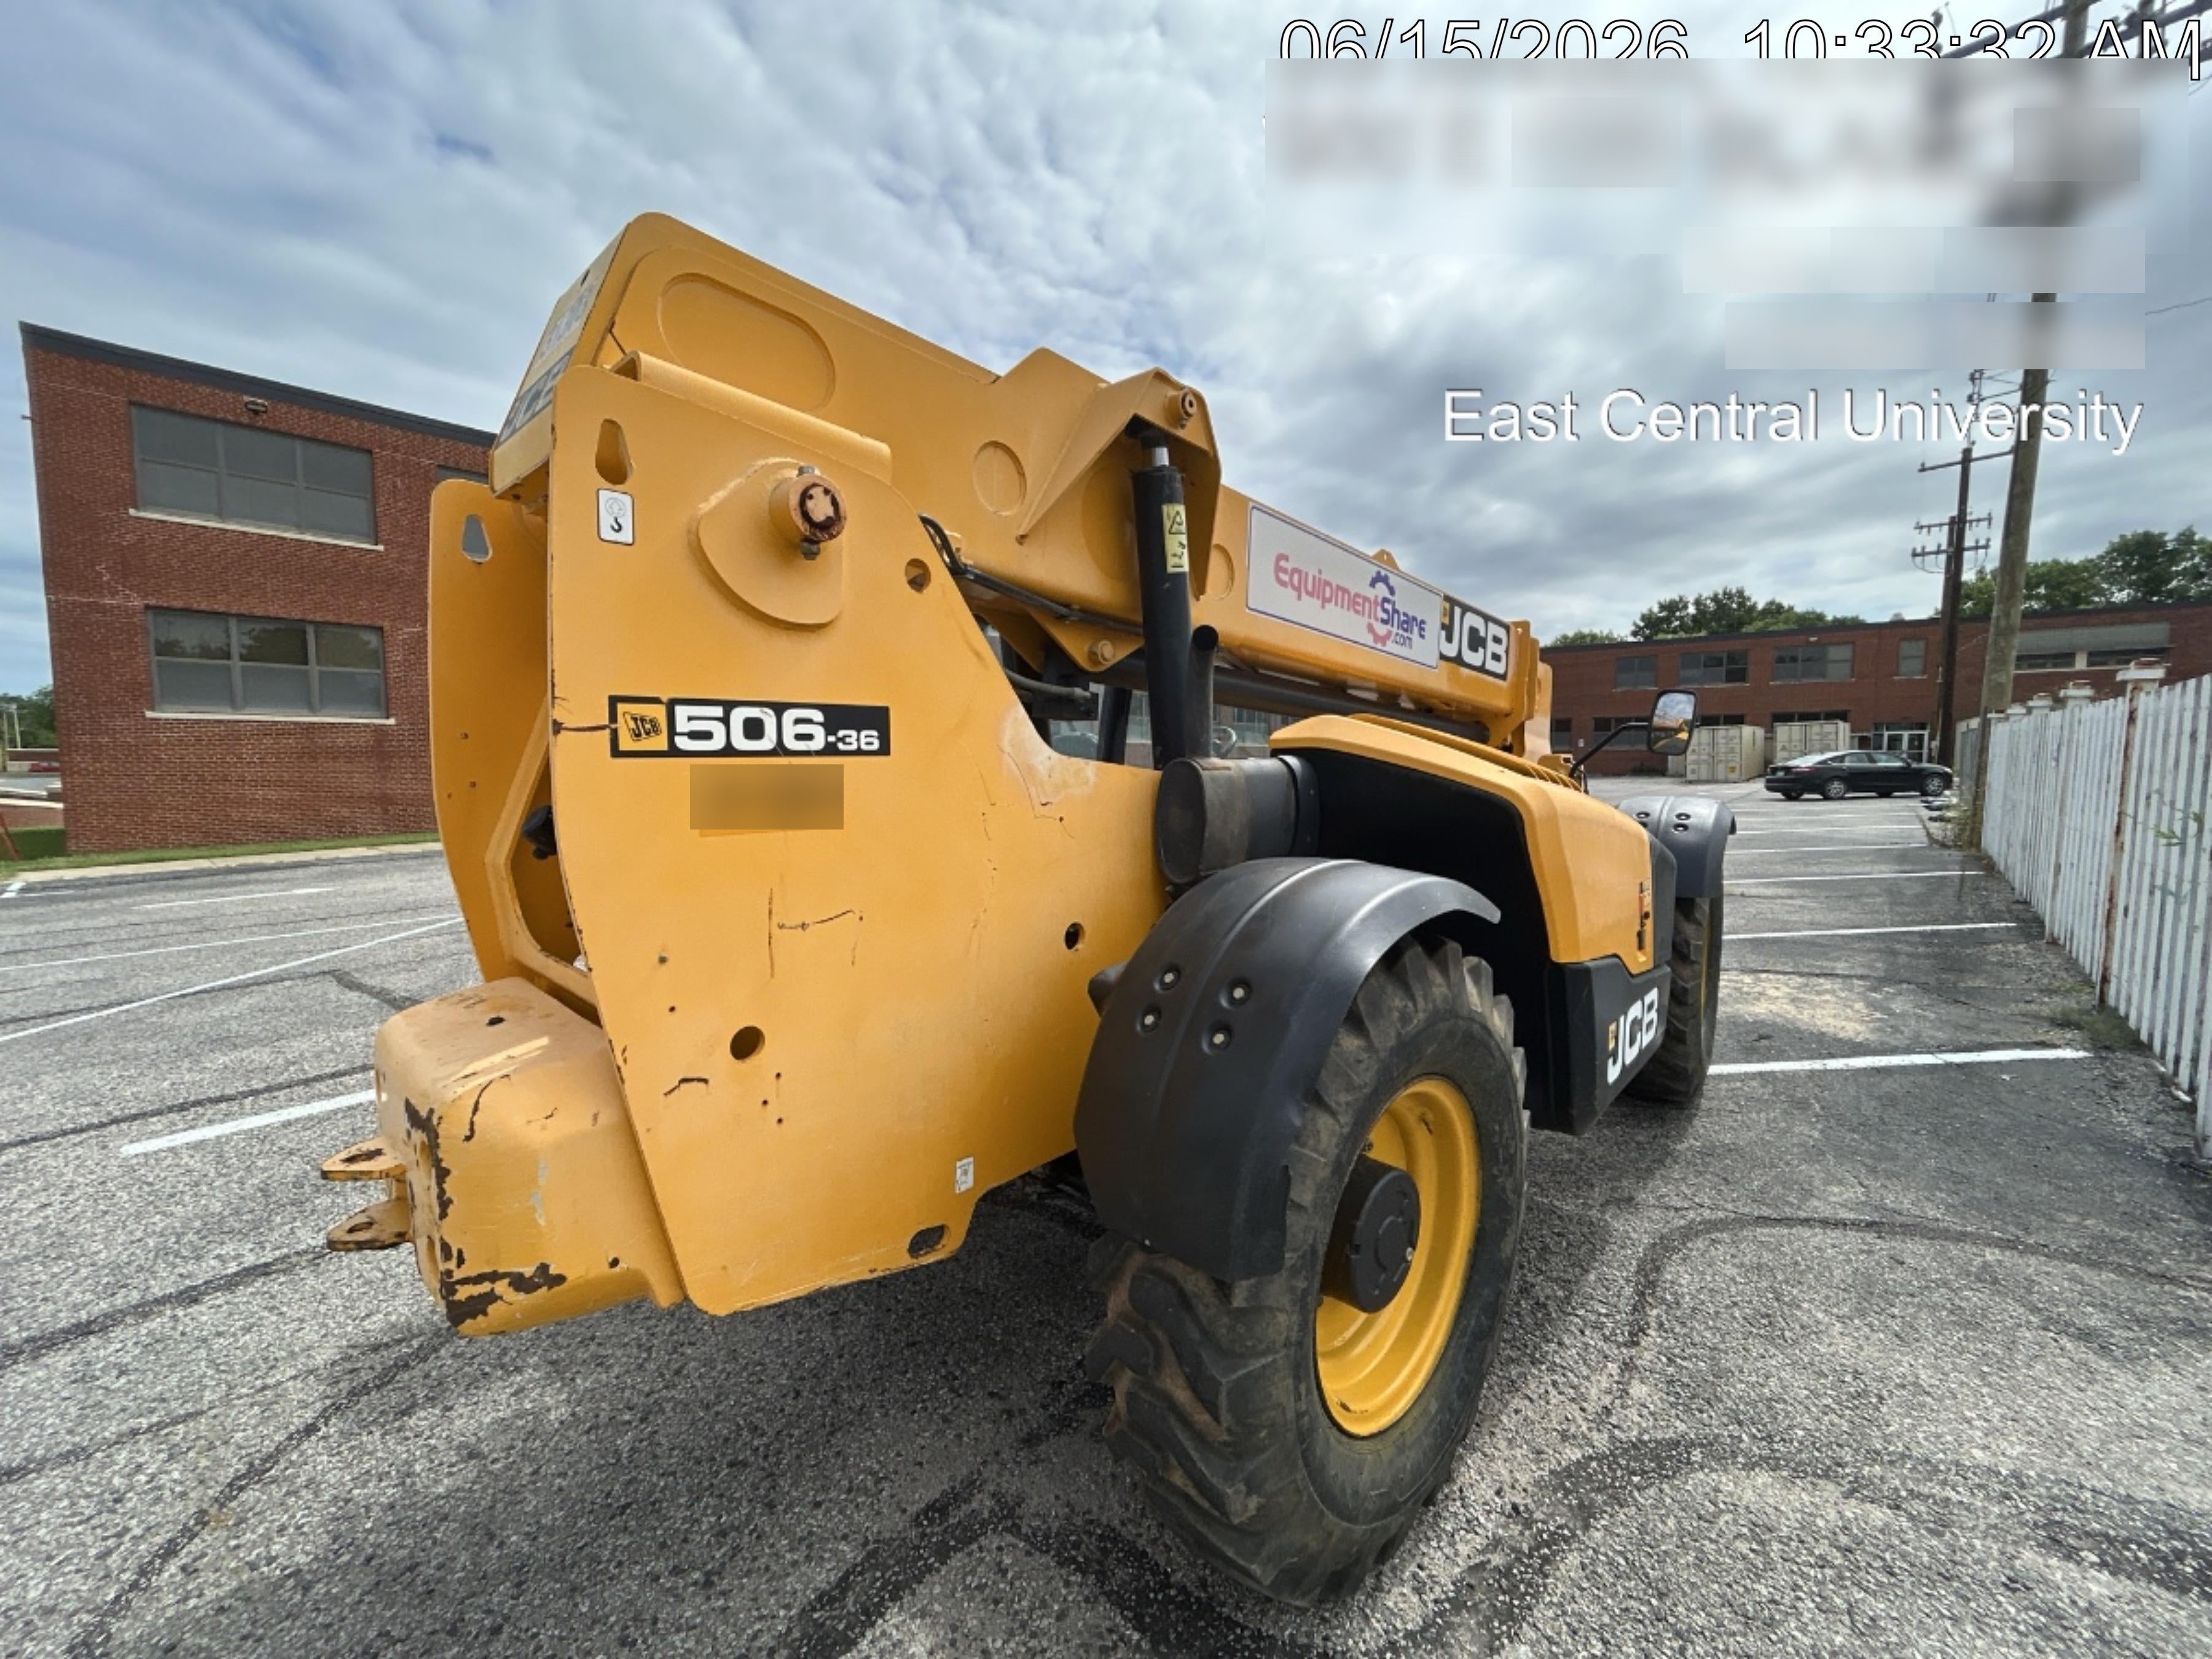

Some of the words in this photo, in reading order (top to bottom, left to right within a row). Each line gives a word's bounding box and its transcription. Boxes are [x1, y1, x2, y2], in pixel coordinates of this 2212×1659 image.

[1274, 552, 1427, 640] EquipmentShare
[1439, 606, 1508, 674] JCB
[629, 713, 660, 739] JCB
[674, 705, 880, 751] 506-36
[1607, 987, 1659, 1085] JCB
